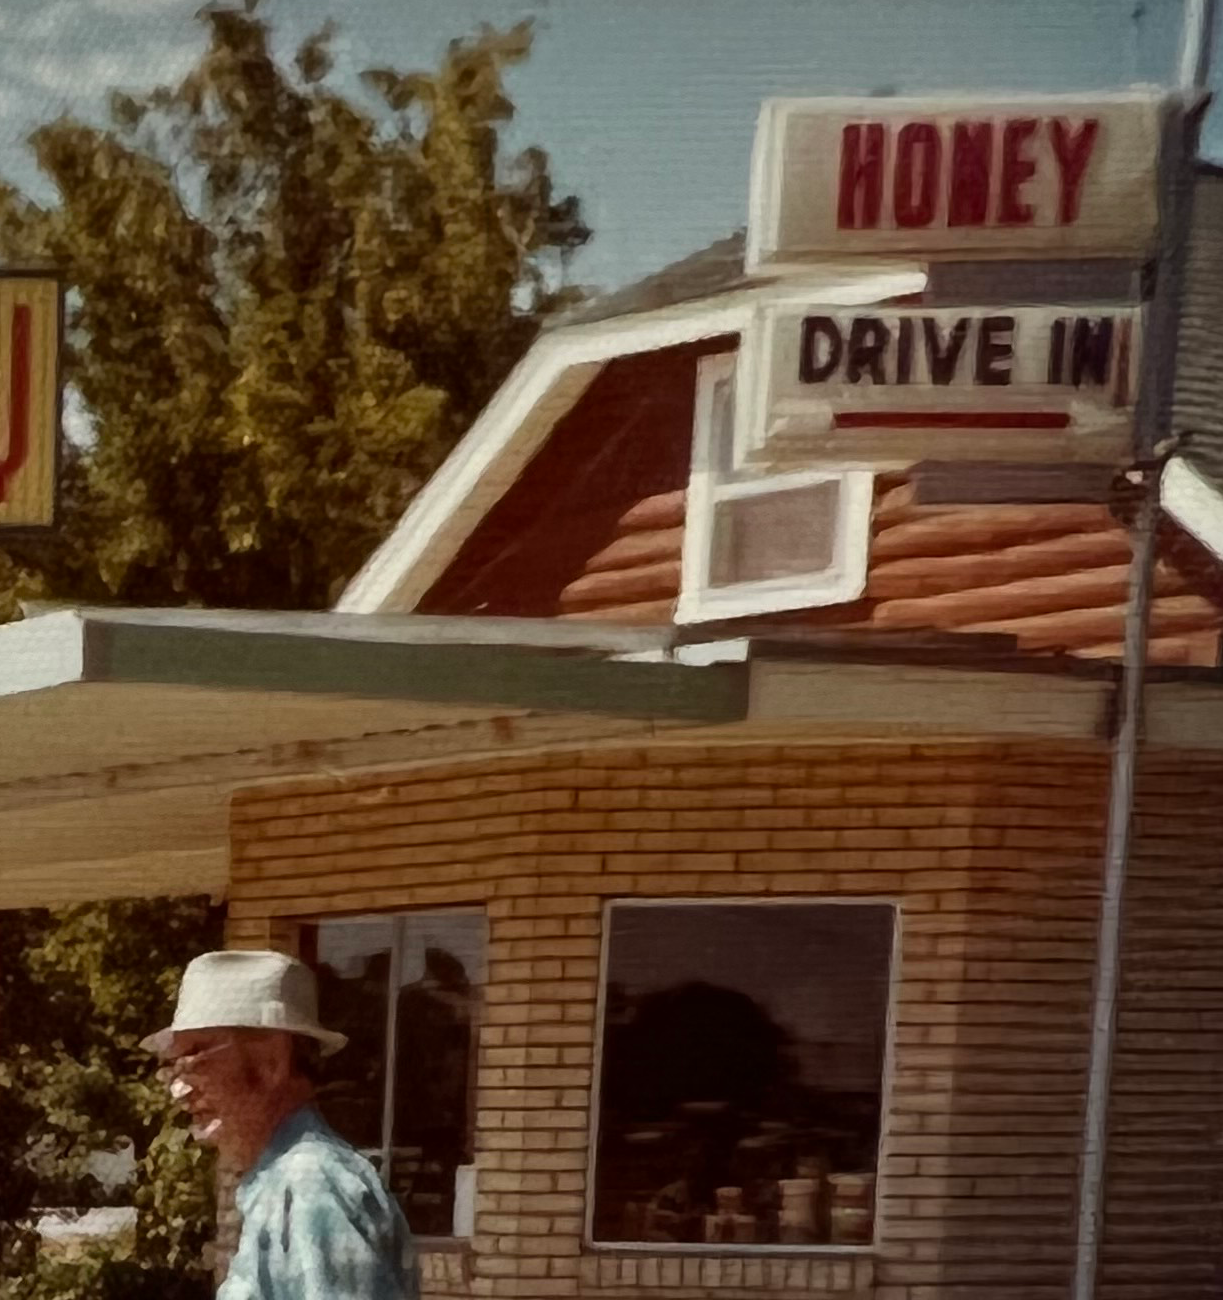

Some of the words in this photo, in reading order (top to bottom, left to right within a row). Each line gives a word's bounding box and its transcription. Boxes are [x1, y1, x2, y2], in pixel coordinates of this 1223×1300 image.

[837, 118, 1099, 229] HONEY
[799, 315, 1016, 386] DRIVE
[1048, 316, 1114, 387] IN
